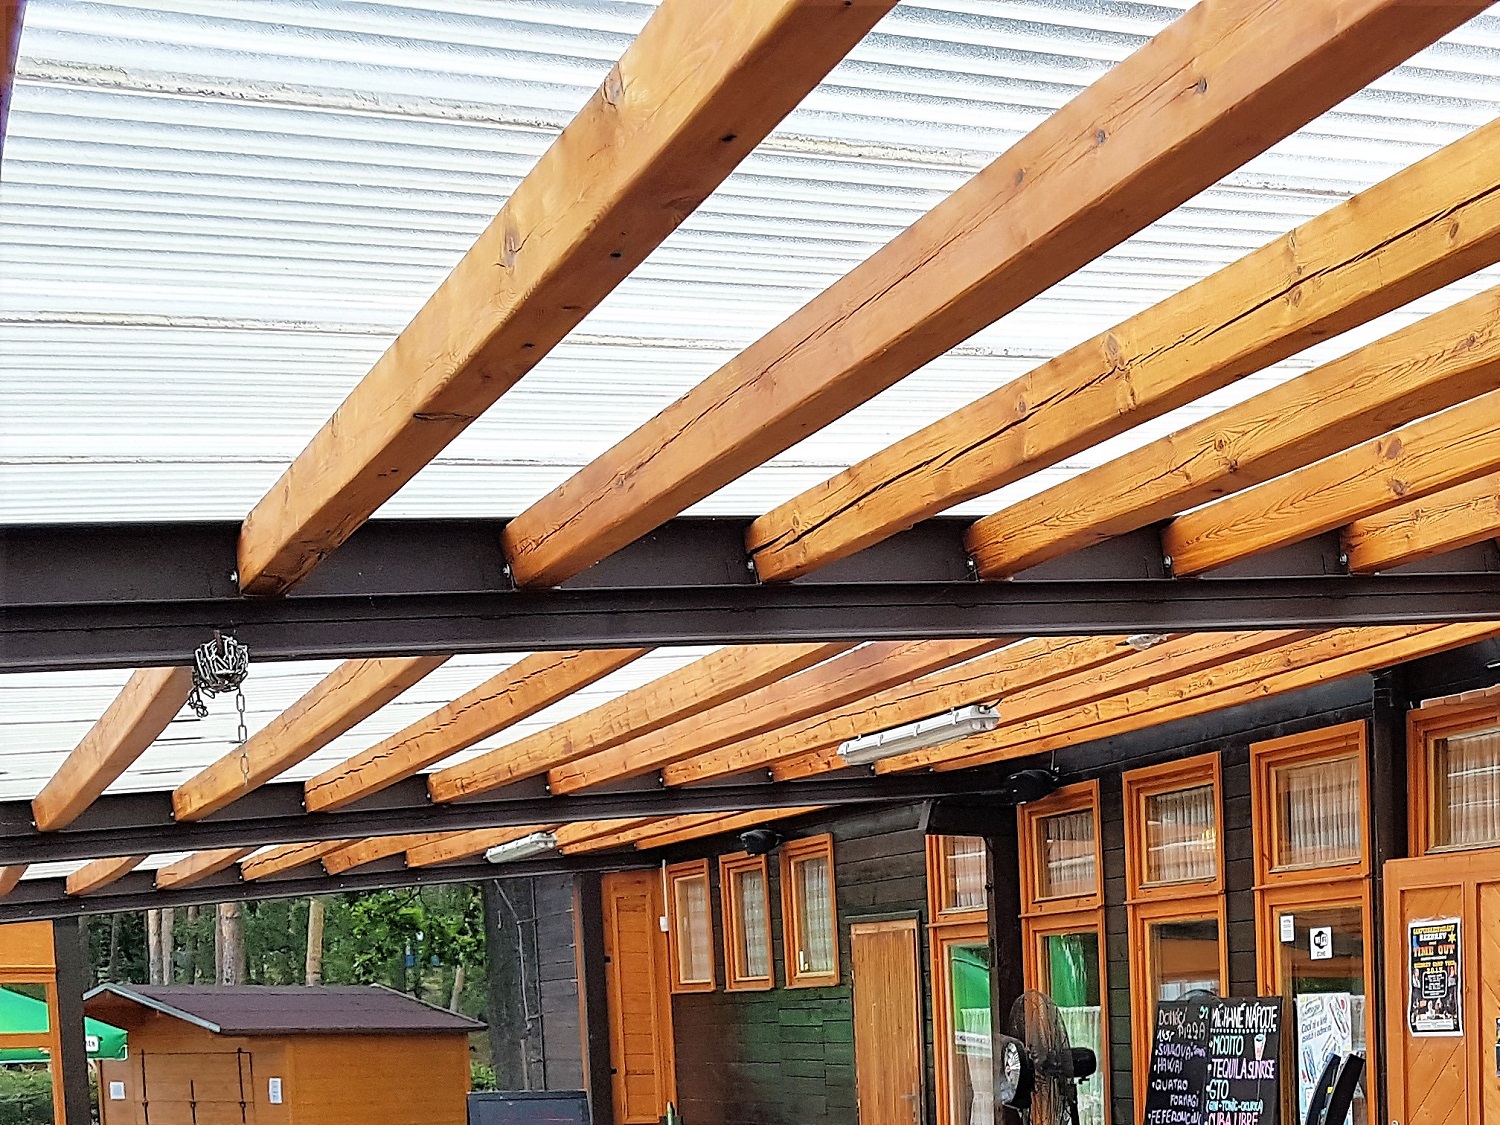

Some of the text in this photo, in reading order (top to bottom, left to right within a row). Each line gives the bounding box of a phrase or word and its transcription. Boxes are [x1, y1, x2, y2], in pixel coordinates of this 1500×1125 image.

[1413, 944, 1456, 957] TIME OUT
[1212, 1034, 1244, 1056] MOJITO
[1212, 1057, 1247, 1079] TEQUILA
